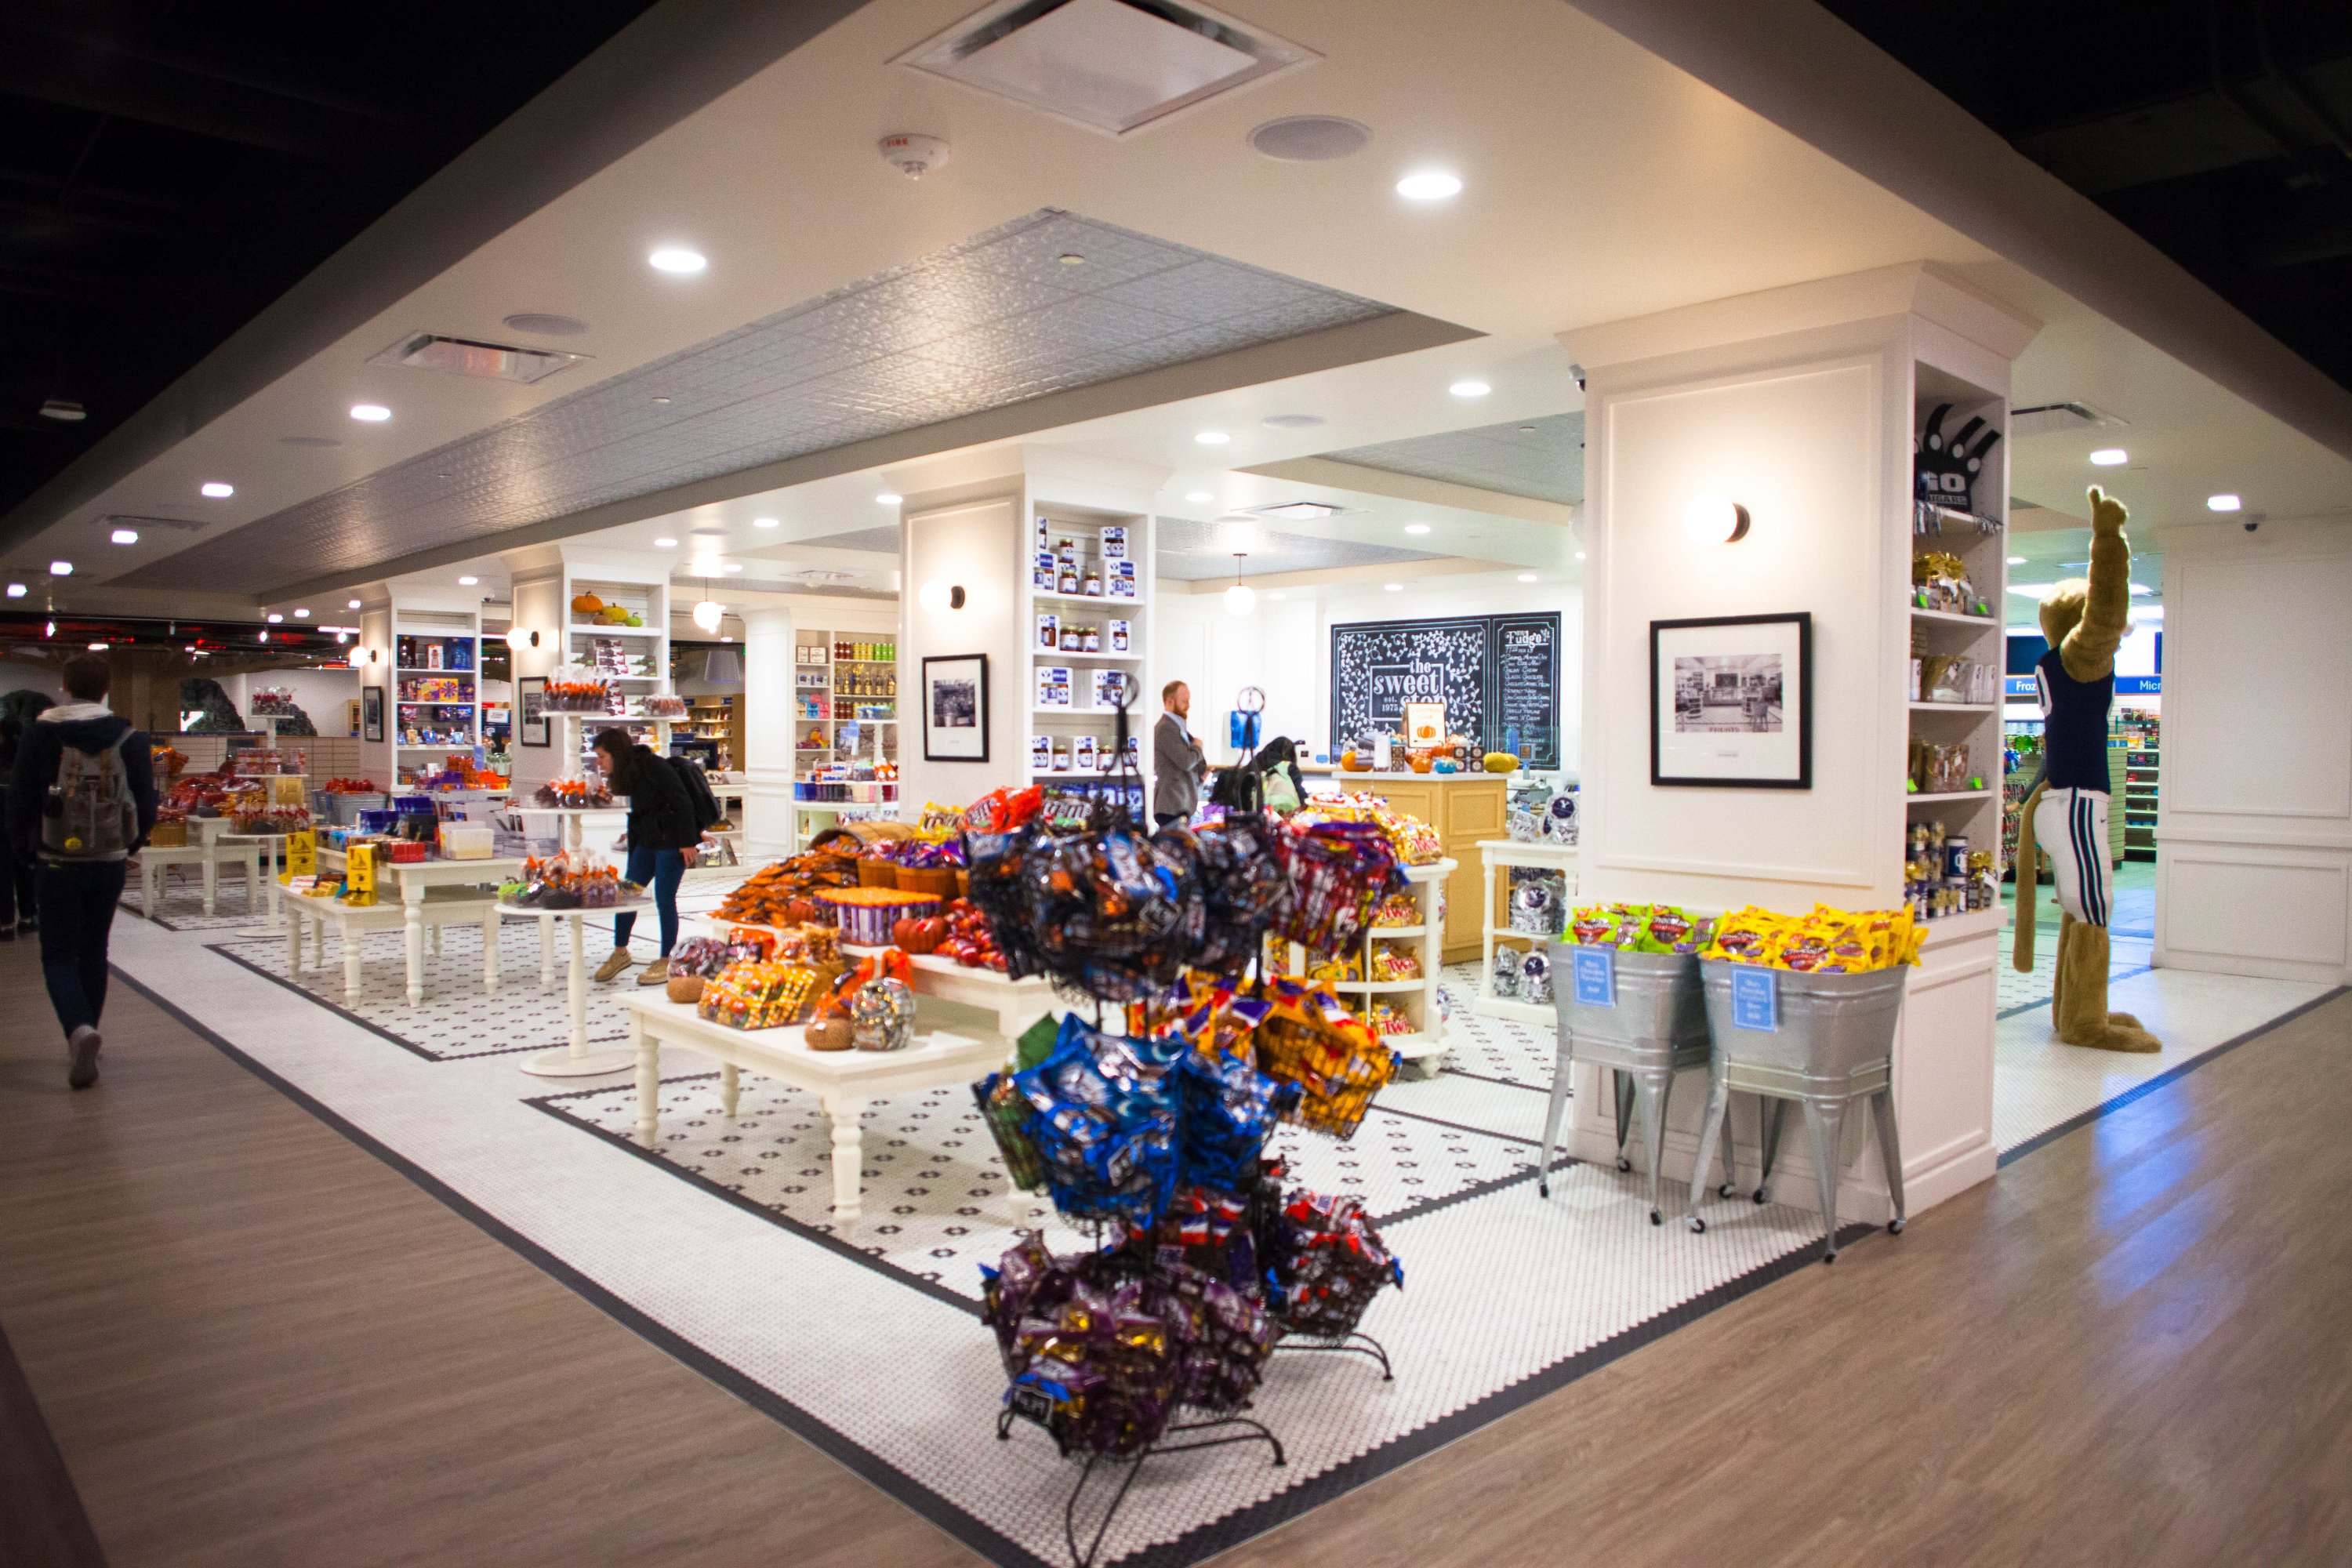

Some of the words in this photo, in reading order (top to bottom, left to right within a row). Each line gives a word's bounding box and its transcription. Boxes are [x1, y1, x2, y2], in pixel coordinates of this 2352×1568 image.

[1505, 630, 1542, 649] Fudge
[1410, 658, 1432, 673] the
[1373, 670, 1439, 695] sweet
[2016, 681, 2037, 691] Froz
[2140, 680, 2161, 690] Micr
[1381, 704, 1399, 713] 1975
